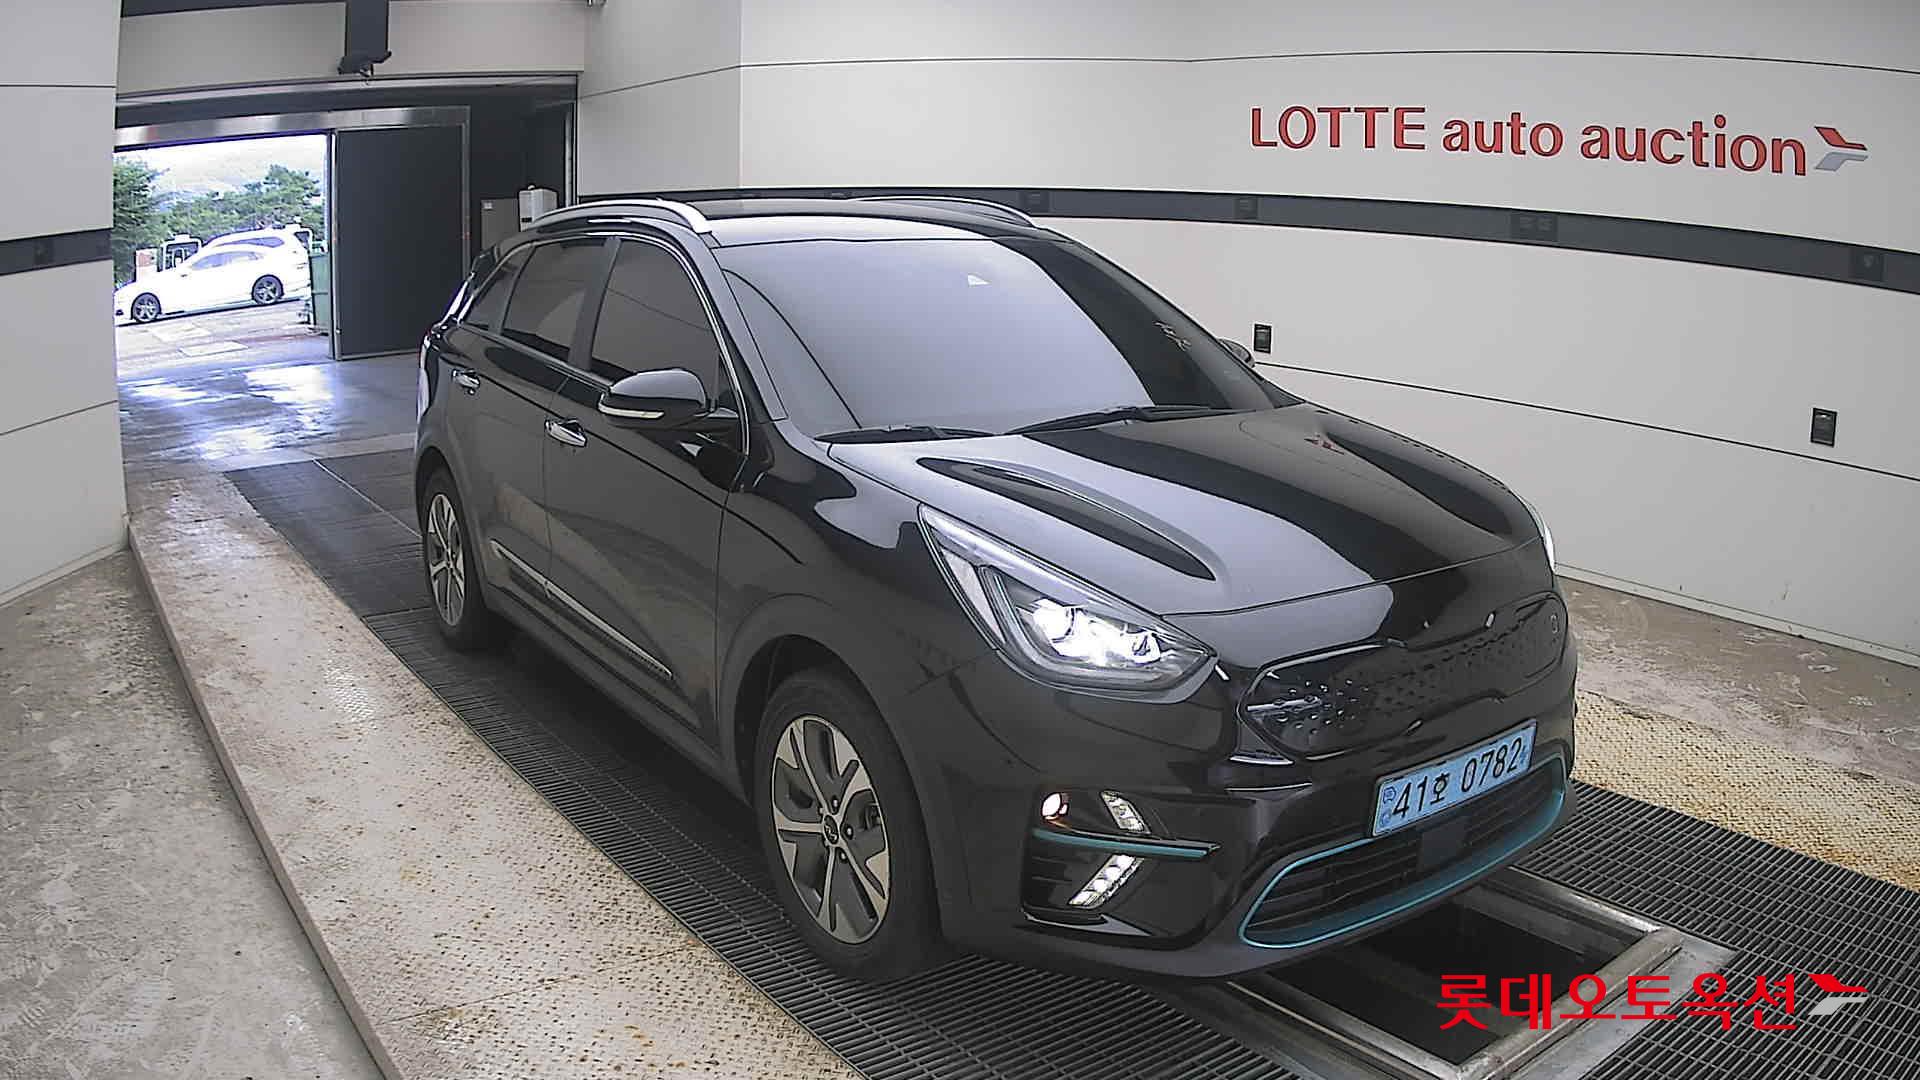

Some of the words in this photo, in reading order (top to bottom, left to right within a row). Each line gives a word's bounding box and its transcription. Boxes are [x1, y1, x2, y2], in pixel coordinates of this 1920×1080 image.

[1251, 105, 1426, 150] LOTTE
[1442, 112, 1564, 157] auto
[1580, 114, 1808, 177] auction
[1392, 772, 1450, 818] 41호
[1461, 736, 1523, 792] 0782
